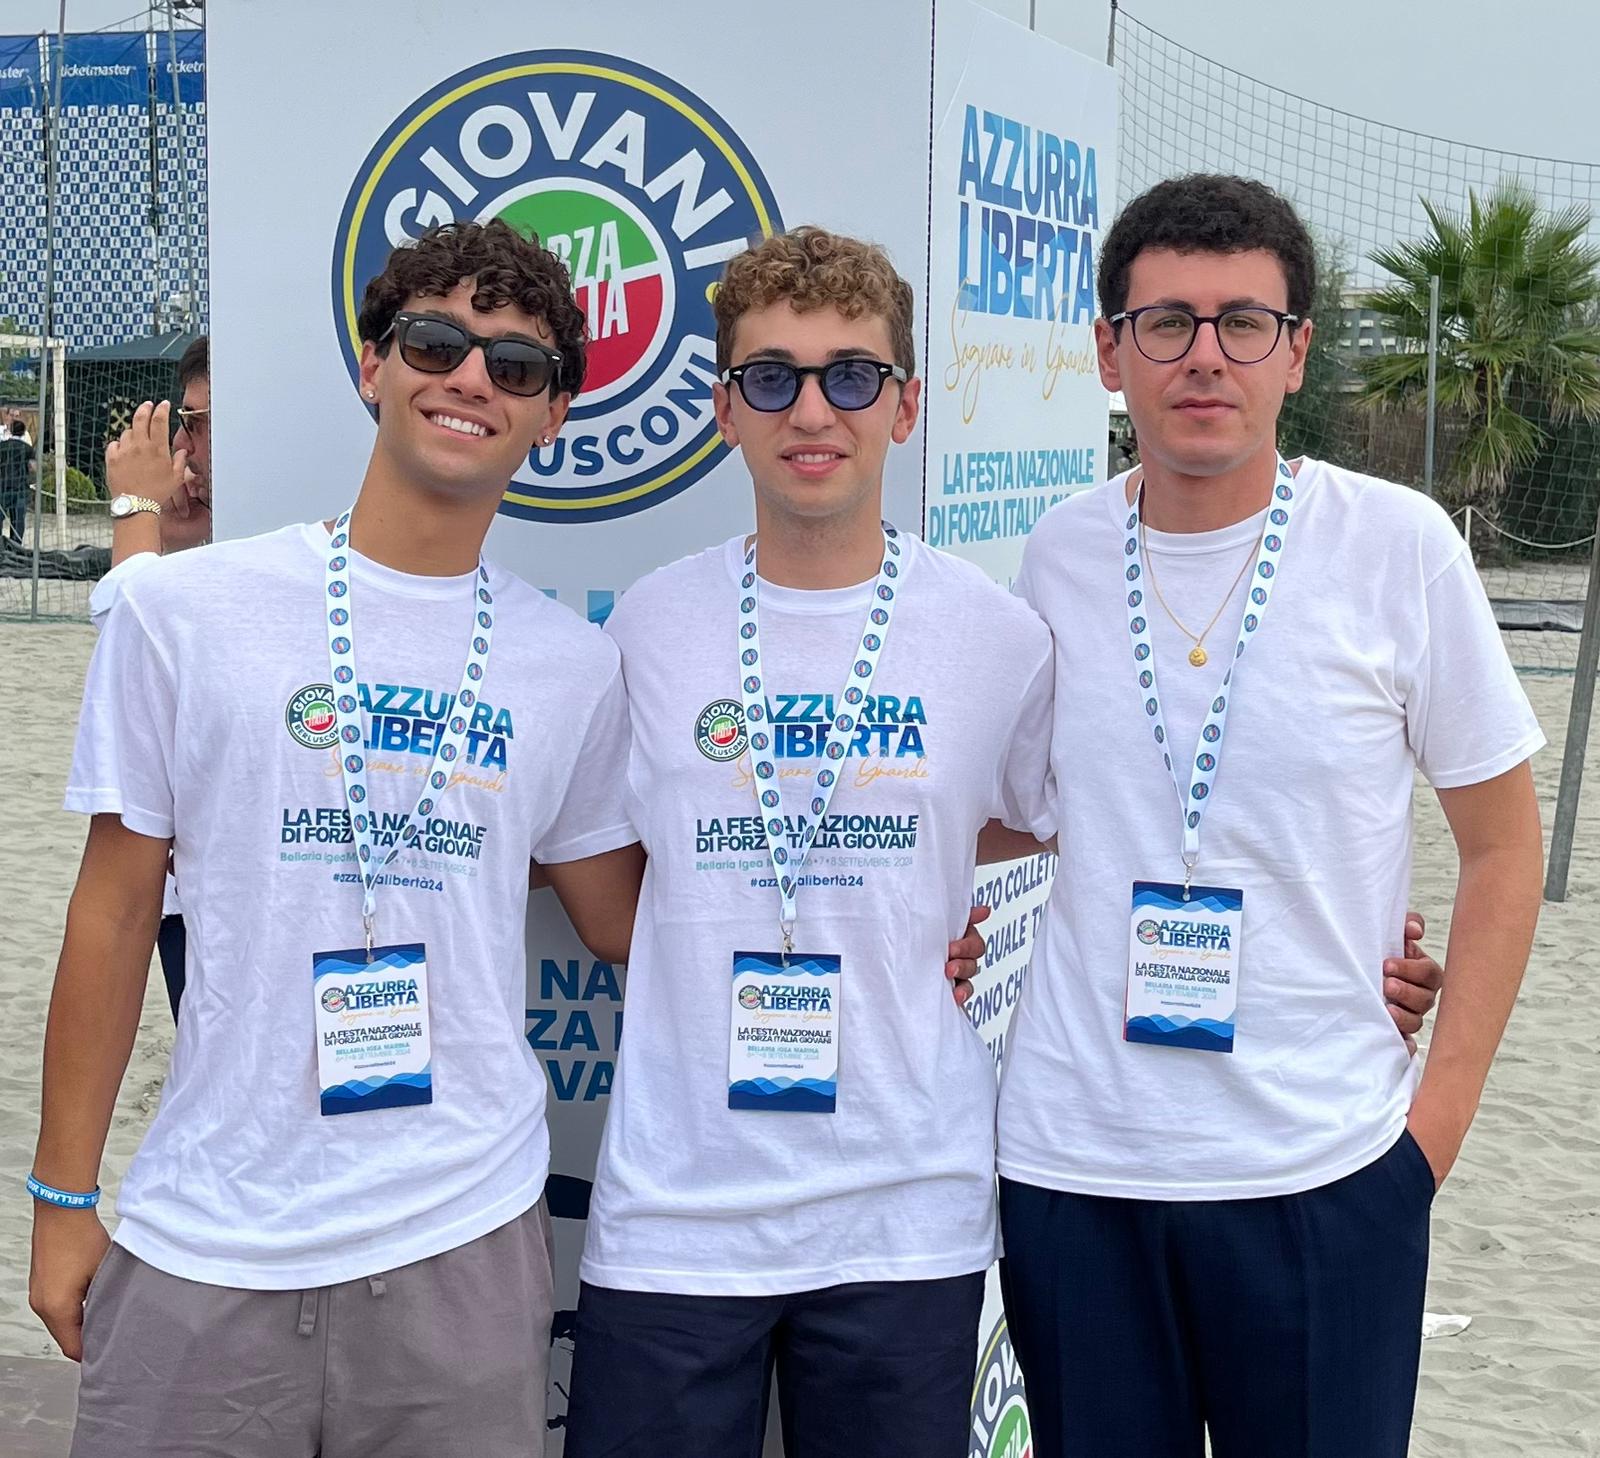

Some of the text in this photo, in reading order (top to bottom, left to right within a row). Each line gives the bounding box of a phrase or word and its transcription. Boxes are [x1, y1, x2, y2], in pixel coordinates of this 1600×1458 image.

[61, 63, 131, 77] ticketmaster
[958, 104, 1098, 230] AZZURRA
[384, 92, 750, 270] GIOVANI
[547, 220, 622, 288] RZA
[529, 352, 718, 476] USCONI
[943, 448, 1094, 495] LA FESTA NAZIONALE
[929, 505, 946, 547] DI
[949, 500, 1000, 545] FORZA
[292, 688, 335, 712] GIOVA
[294, 723, 338, 743] BERLUSCO
[363, 715, 507, 772] IBETA
[701, 737, 746, 756] BERLUSCONI
[281, 827, 301, 844] DI
[304, 826, 355, 844] FORZ
[283, 808, 487, 844] LA FESA NAIONALE
[697, 818, 724, 836] LA
[727, 816, 795, 835] FESA
[696, 836, 713, 853] DI
[717, 835, 769, 852] FORZ
[696, 861, 736, 871] Bellaria
[739, 859, 763, 872] Igea
[751, 875, 864, 888] #azzalibertà24
[1160, 919, 1231, 937] AZZURRA
[985, 913, 1027, 968] QUALE
[1136, 962, 1230, 977] LA FESTA NAZIONALE
[345, 979, 418, 996] AZZURRA
[761, 985, 831, 998] AZZURRA
[324, 1022, 421, 1040] LA FESTA NAZIONALE
[751, 1028, 778, 1036] FESTA
[780, 1029, 831, 1038] NAZIONALE
[40, 1188, 84, 1205] BELLARIA
